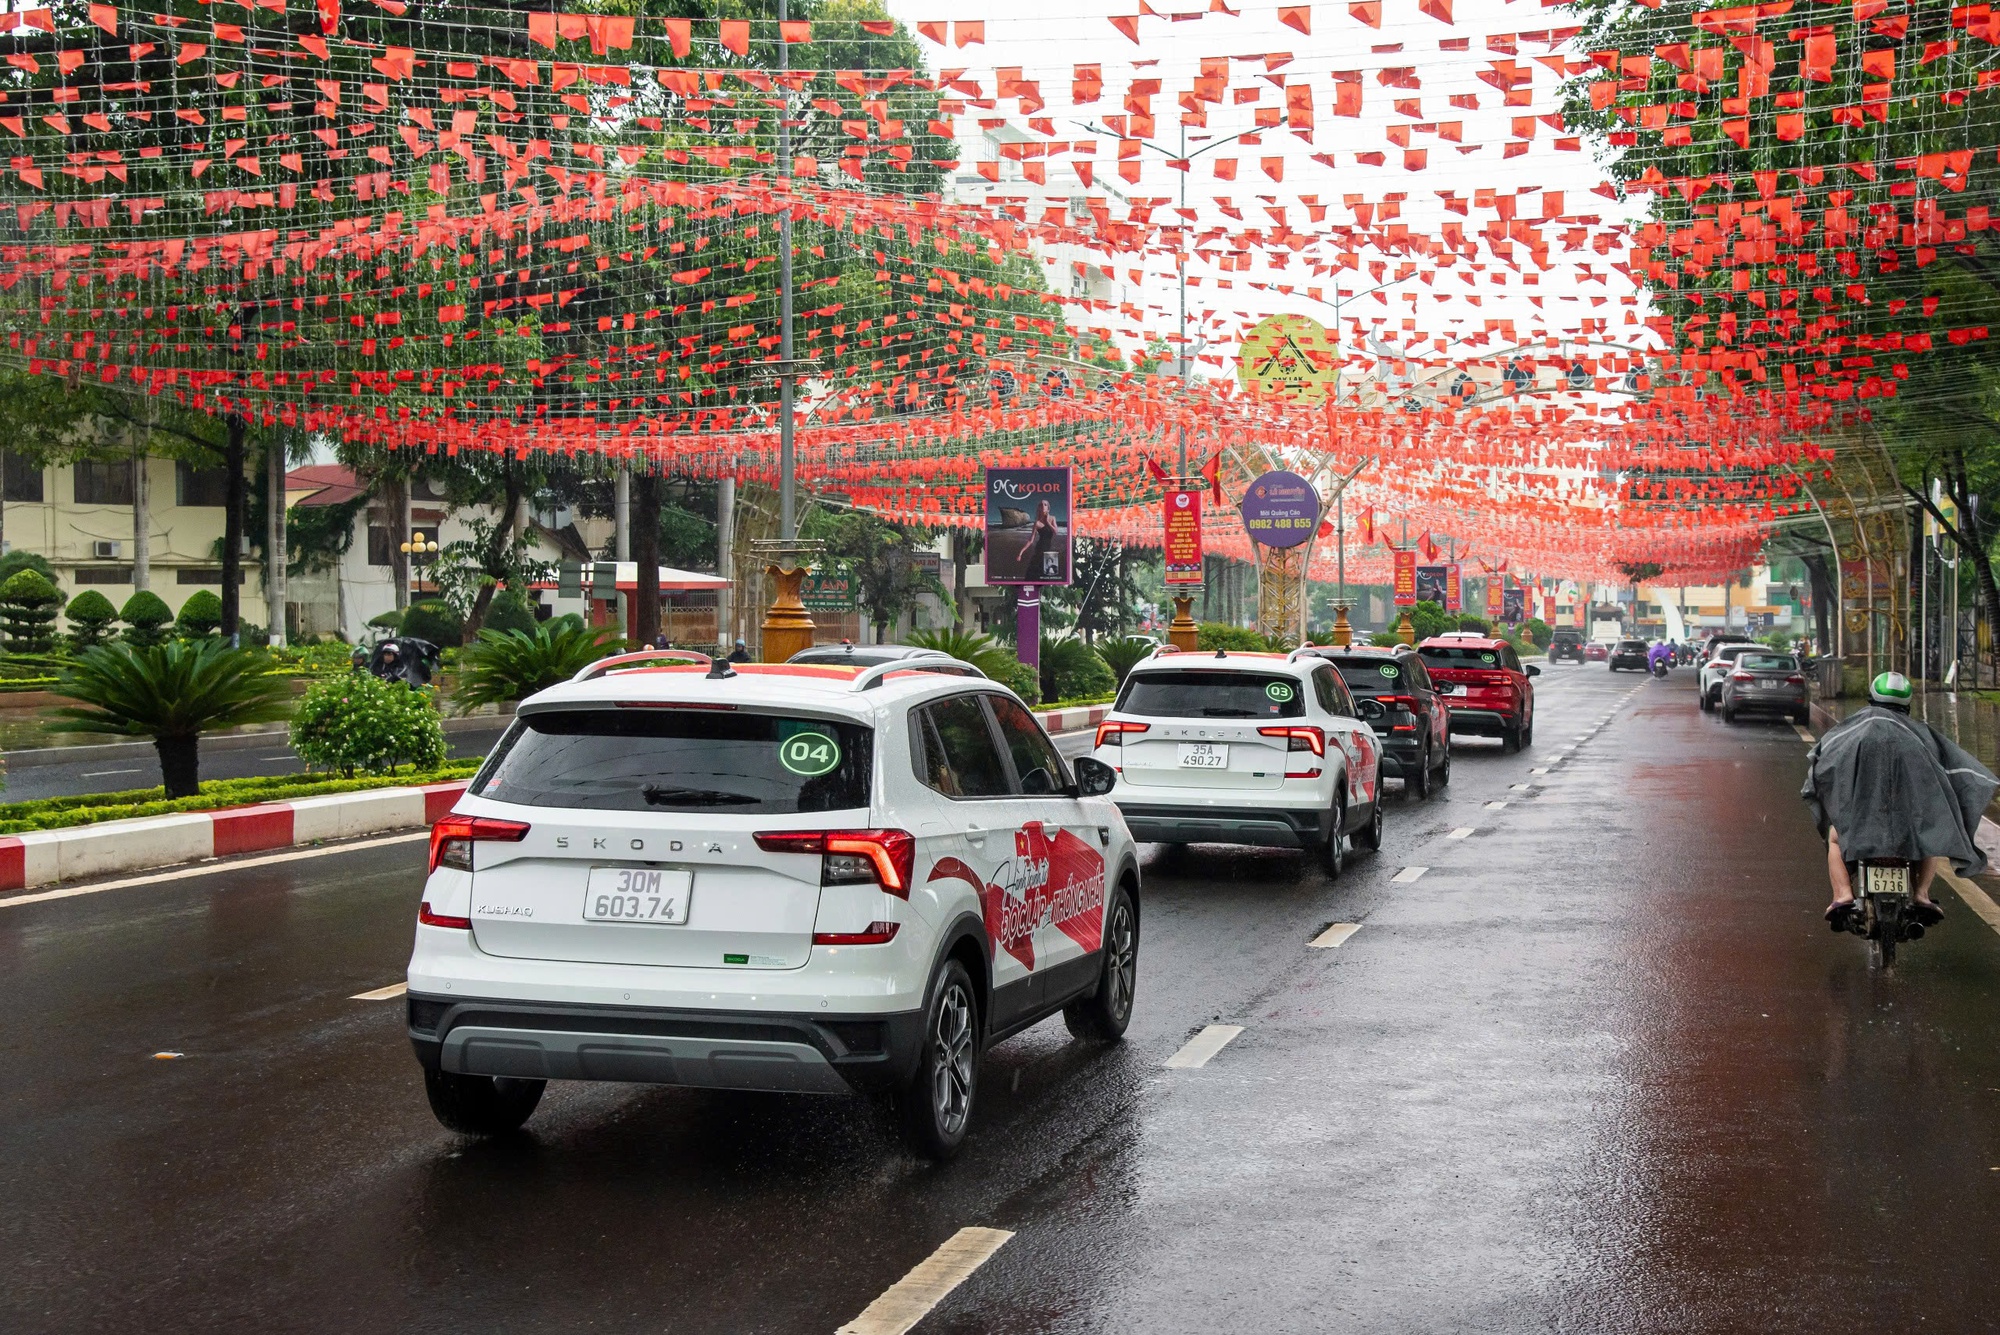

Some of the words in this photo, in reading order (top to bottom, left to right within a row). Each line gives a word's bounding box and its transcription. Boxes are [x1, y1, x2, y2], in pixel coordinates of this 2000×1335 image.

[1250, 519, 1272, 529] 0982
[1275, 519, 1291, 528] 488
[1295, 518, 1311, 528] 655
[1383, 667, 1396, 675] 02
[1271, 686, 1288, 697] 03
[790, 742, 829, 763] 04
[1192, 745, 1213, 755] 35A
[1183, 756, 1222, 766] 490.27
[556, 836, 723, 854] SKODA
[617, 870, 662, 893] 30M
[1874, 880, 1903, 892] 6736
[478, 904, 534, 917] KUSHAQ
[595, 894, 675, 919] 603.74
